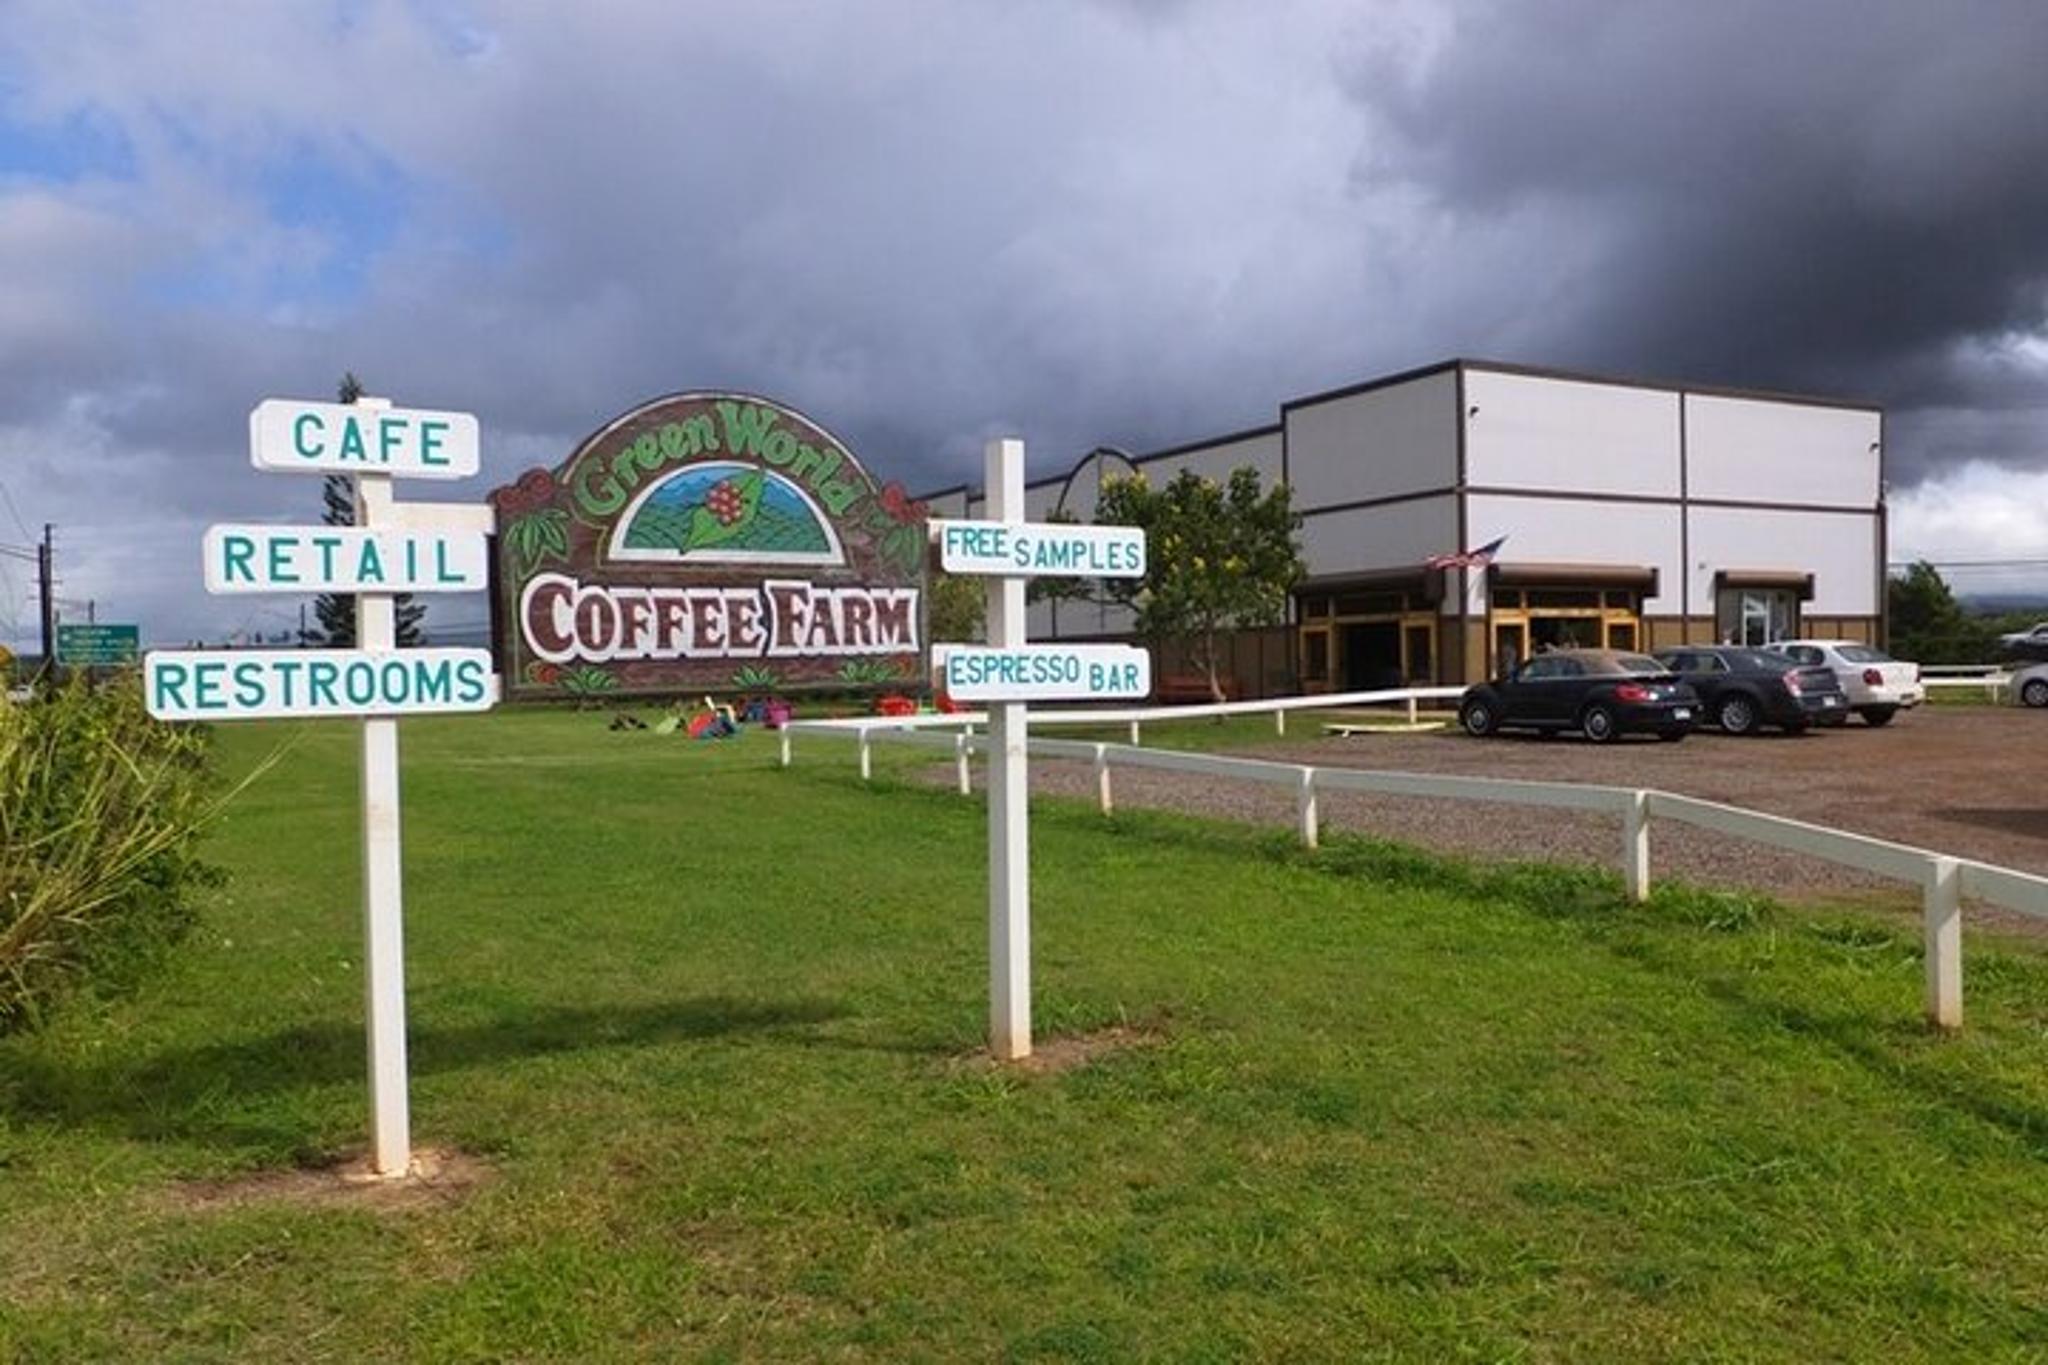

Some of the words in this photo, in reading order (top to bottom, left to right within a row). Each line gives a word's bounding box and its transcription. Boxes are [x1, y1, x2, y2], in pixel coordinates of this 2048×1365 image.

[293, 413, 451, 465] CAFE
[575, 416, 720, 516] Green
[717, 401, 867, 517] World
[223, 536, 465, 582] RETAIL
[946, 528, 1008, 558] FREE
[1014, 538, 1140, 570] SAMPLES
[524, 578, 764, 657] COFFEE
[774, 583, 916, 650] FARM
[155, 661, 485, 710] RESTROOMS
[949, 655, 1081, 684] ESPRESSO
[1089, 664, 1139, 692] BAR
